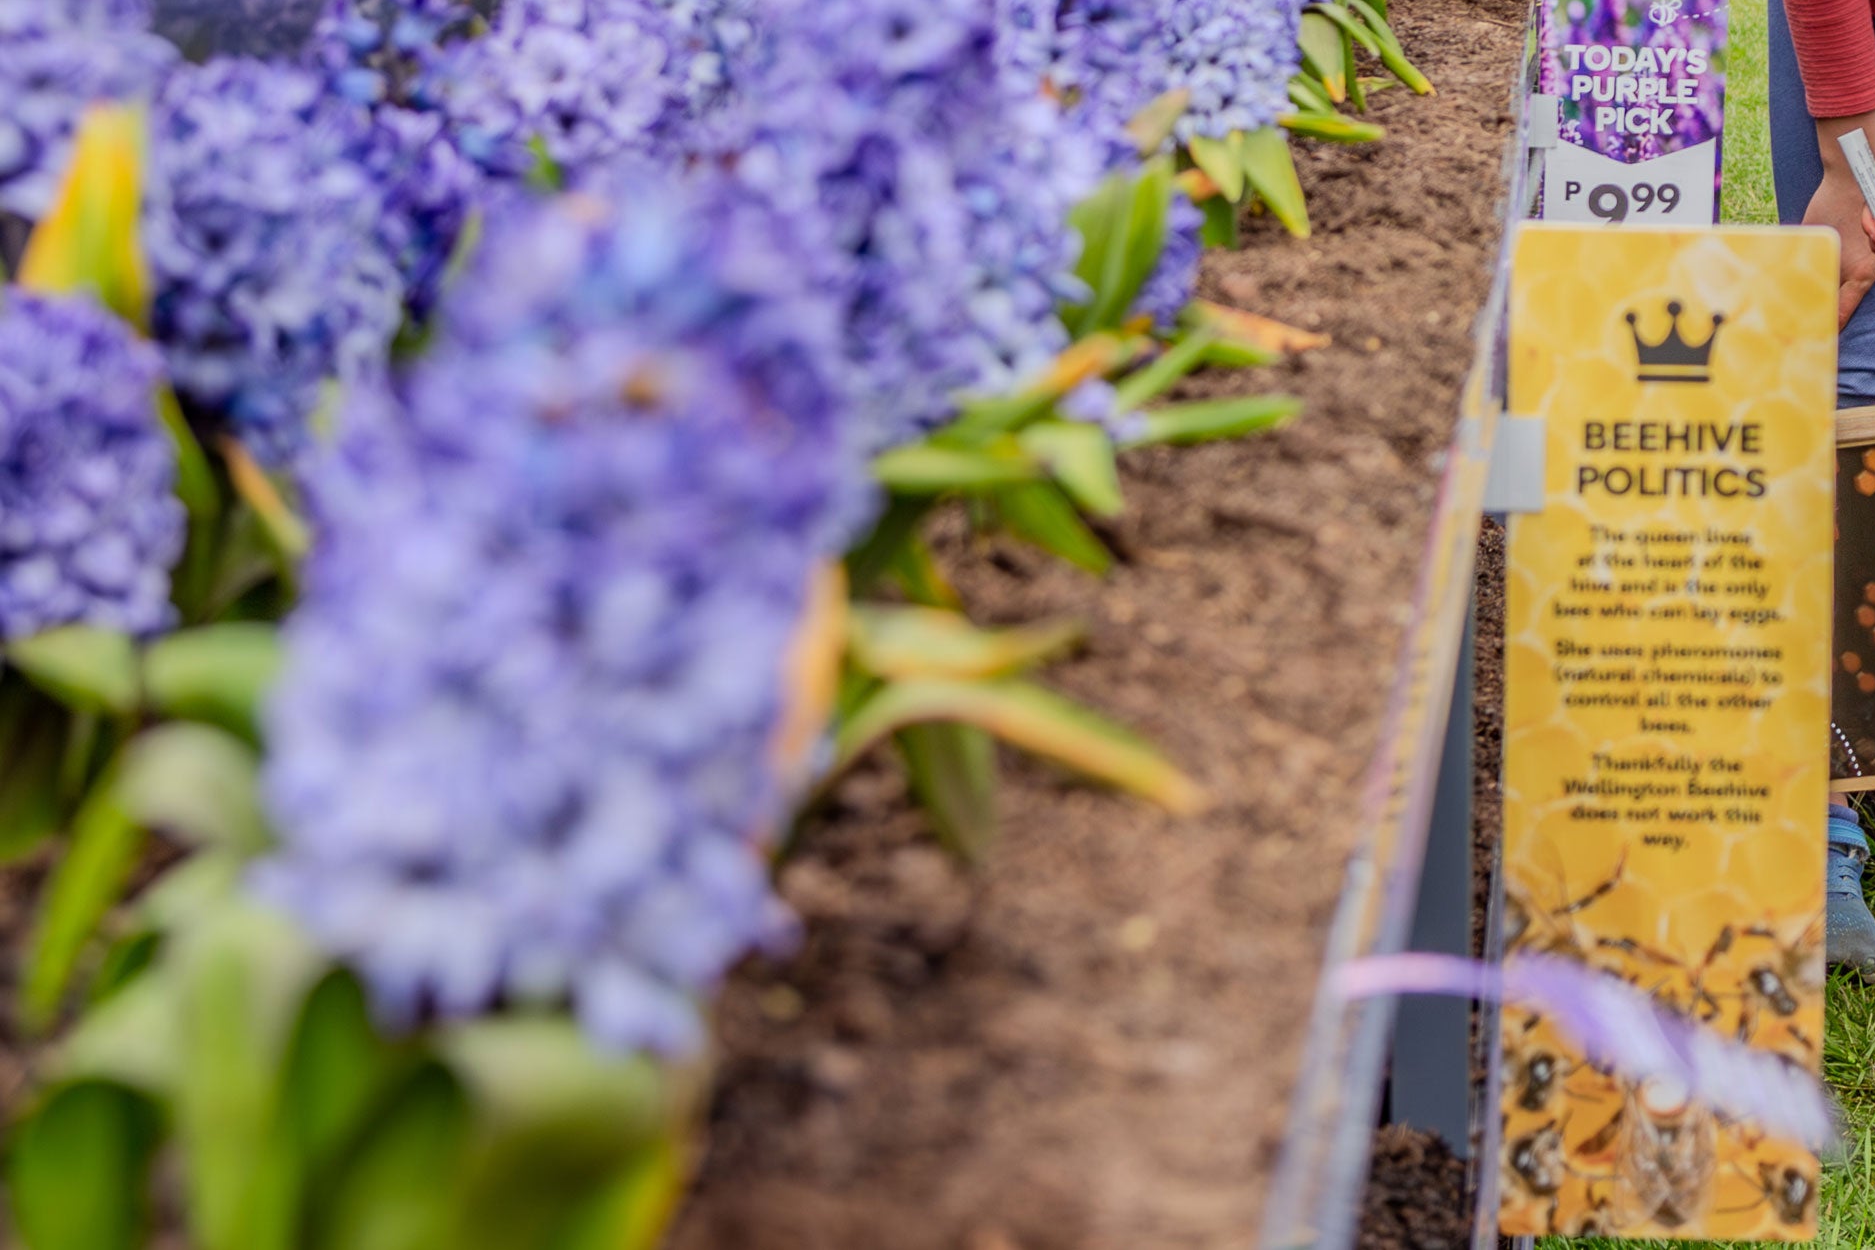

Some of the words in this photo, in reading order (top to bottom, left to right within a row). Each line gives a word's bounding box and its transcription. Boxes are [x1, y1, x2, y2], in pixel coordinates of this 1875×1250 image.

[1572, 75, 1699, 105] PURPLE
[1595, 106, 1674, 135] PICK
[1584, 421, 1763, 453] BEEHIVE
[1578, 466, 1767, 499] POLITICS
[1590, 526, 1625, 543] The
[1636, 529, 1694, 545] queen
[1706, 528, 1752, 544] lives
[1579, 554, 1593, 568] at
[1604, 553, 1634, 568] the
[1644, 553, 1693, 568] heart
[1704, 554, 1724, 568] of
[1730, 554, 1763, 569] the
[1570, 578, 1611, 593] hive
[1620, 579, 1659, 594] and
[1686, 579, 1717, 594] the
[1726, 580, 1770, 600] only
[1554, 604, 1592, 618] bee
[1600, 604, 1642, 619] who
[1650, 607, 1684, 619] can
[1693, 606, 1719, 623] lay
[1556, 641, 1592, 657] She
[1761, 670, 1783, 685] to
[1564, 692, 1640, 708] control
[1647, 692, 1669, 708] all
[1677, 692, 1709, 709] the
[1718, 693, 1772, 710] other
[1591, 754, 1702, 774] Thankfully
[1708, 756, 1743, 773] the
[1563, 778, 1677, 800] Wellington
[1570, 807, 1618, 822] does
[1627, 808, 1660, 822] not
[1669, 808, 1717, 823] work
[1725, 808, 1761, 824] this
